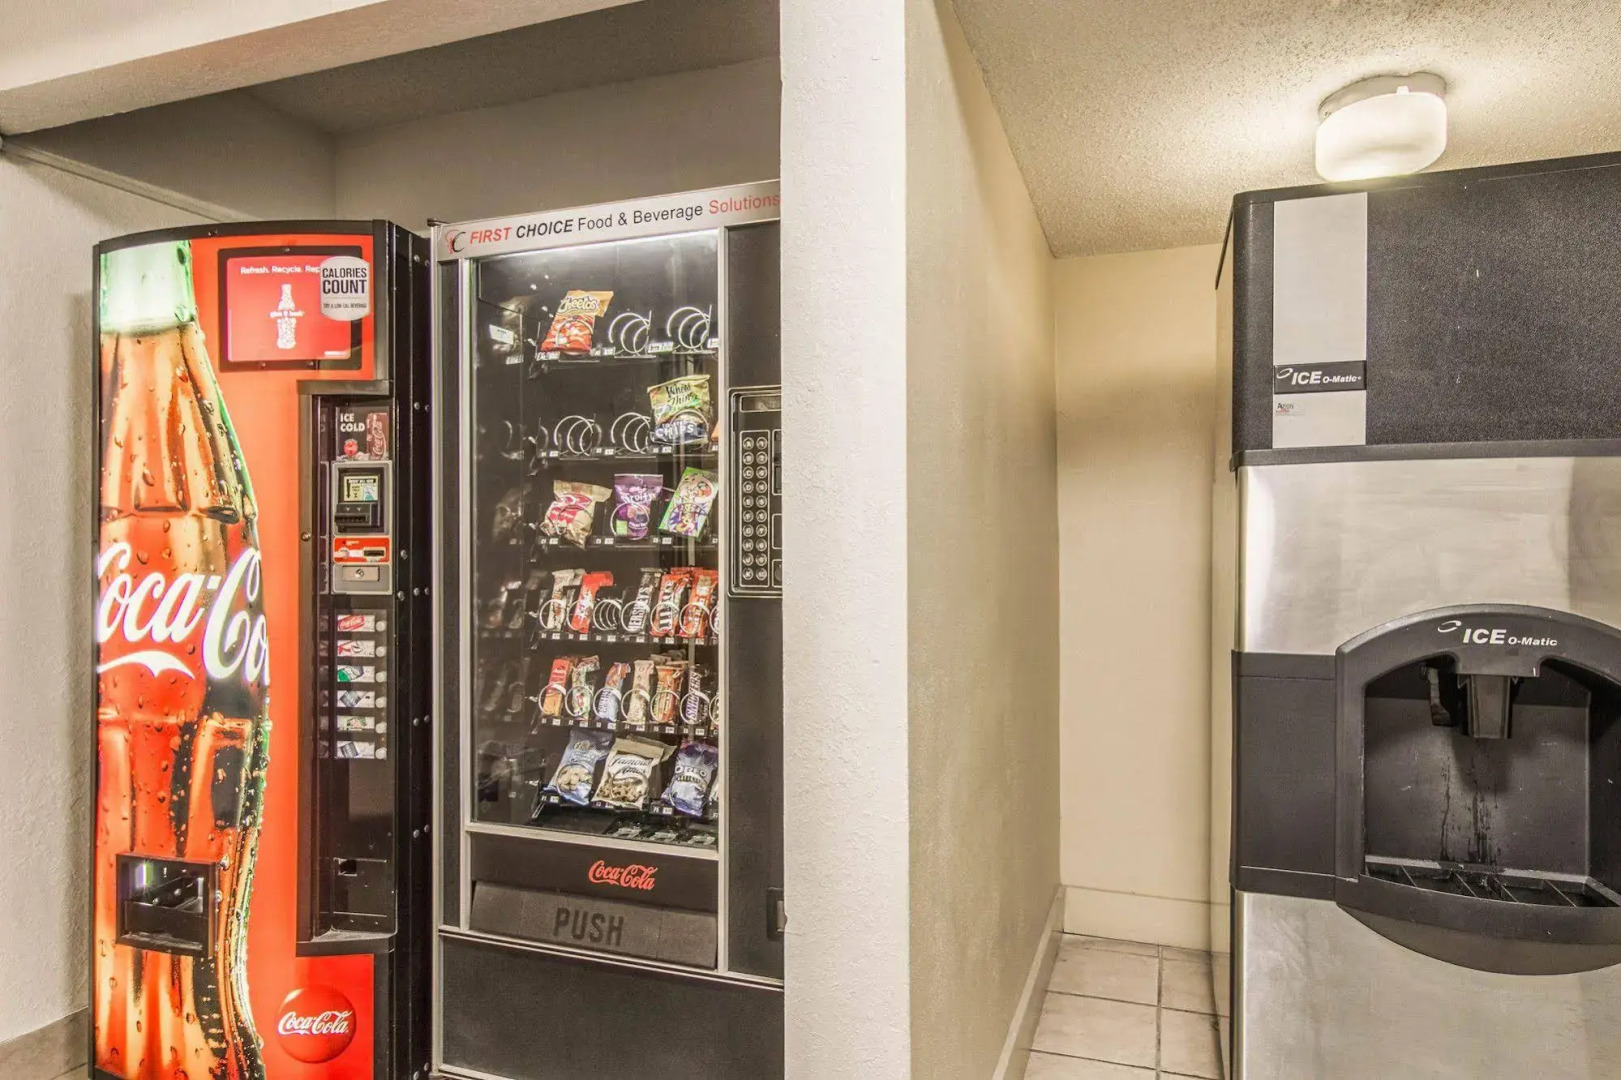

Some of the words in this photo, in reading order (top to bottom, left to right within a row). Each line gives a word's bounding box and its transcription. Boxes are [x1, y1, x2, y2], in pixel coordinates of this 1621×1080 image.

[469, 226, 512, 245] FIRST
[516, 218, 574, 239] CHOICE
[577, 213, 613, 232] Food
[617, 212, 628, 226] &
[633, 205, 703, 224] Beverage
[708, 194, 781, 215] Solutions
[322, 267, 367, 279] CALORIES
[322, 279, 367, 294] COUNT
[558, 297, 598, 313] Cheetos
[1291, 370, 1323, 386] ICE
[340, 413, 355, 423] ICE
[340, 422, 366, 433] COLD
[655, 423, 695, 438] CHIPS
[1462, 628, 1507, 644] ICE
[1507, 636, 1558, 646] O-Matic
[675, 765, 707, 778] OREO
[588, 860, 658, 890] Coca-Cola
[553, 907, 624, 947] PUSH
[277, 1010, 353, 1035] Coca-Cola
